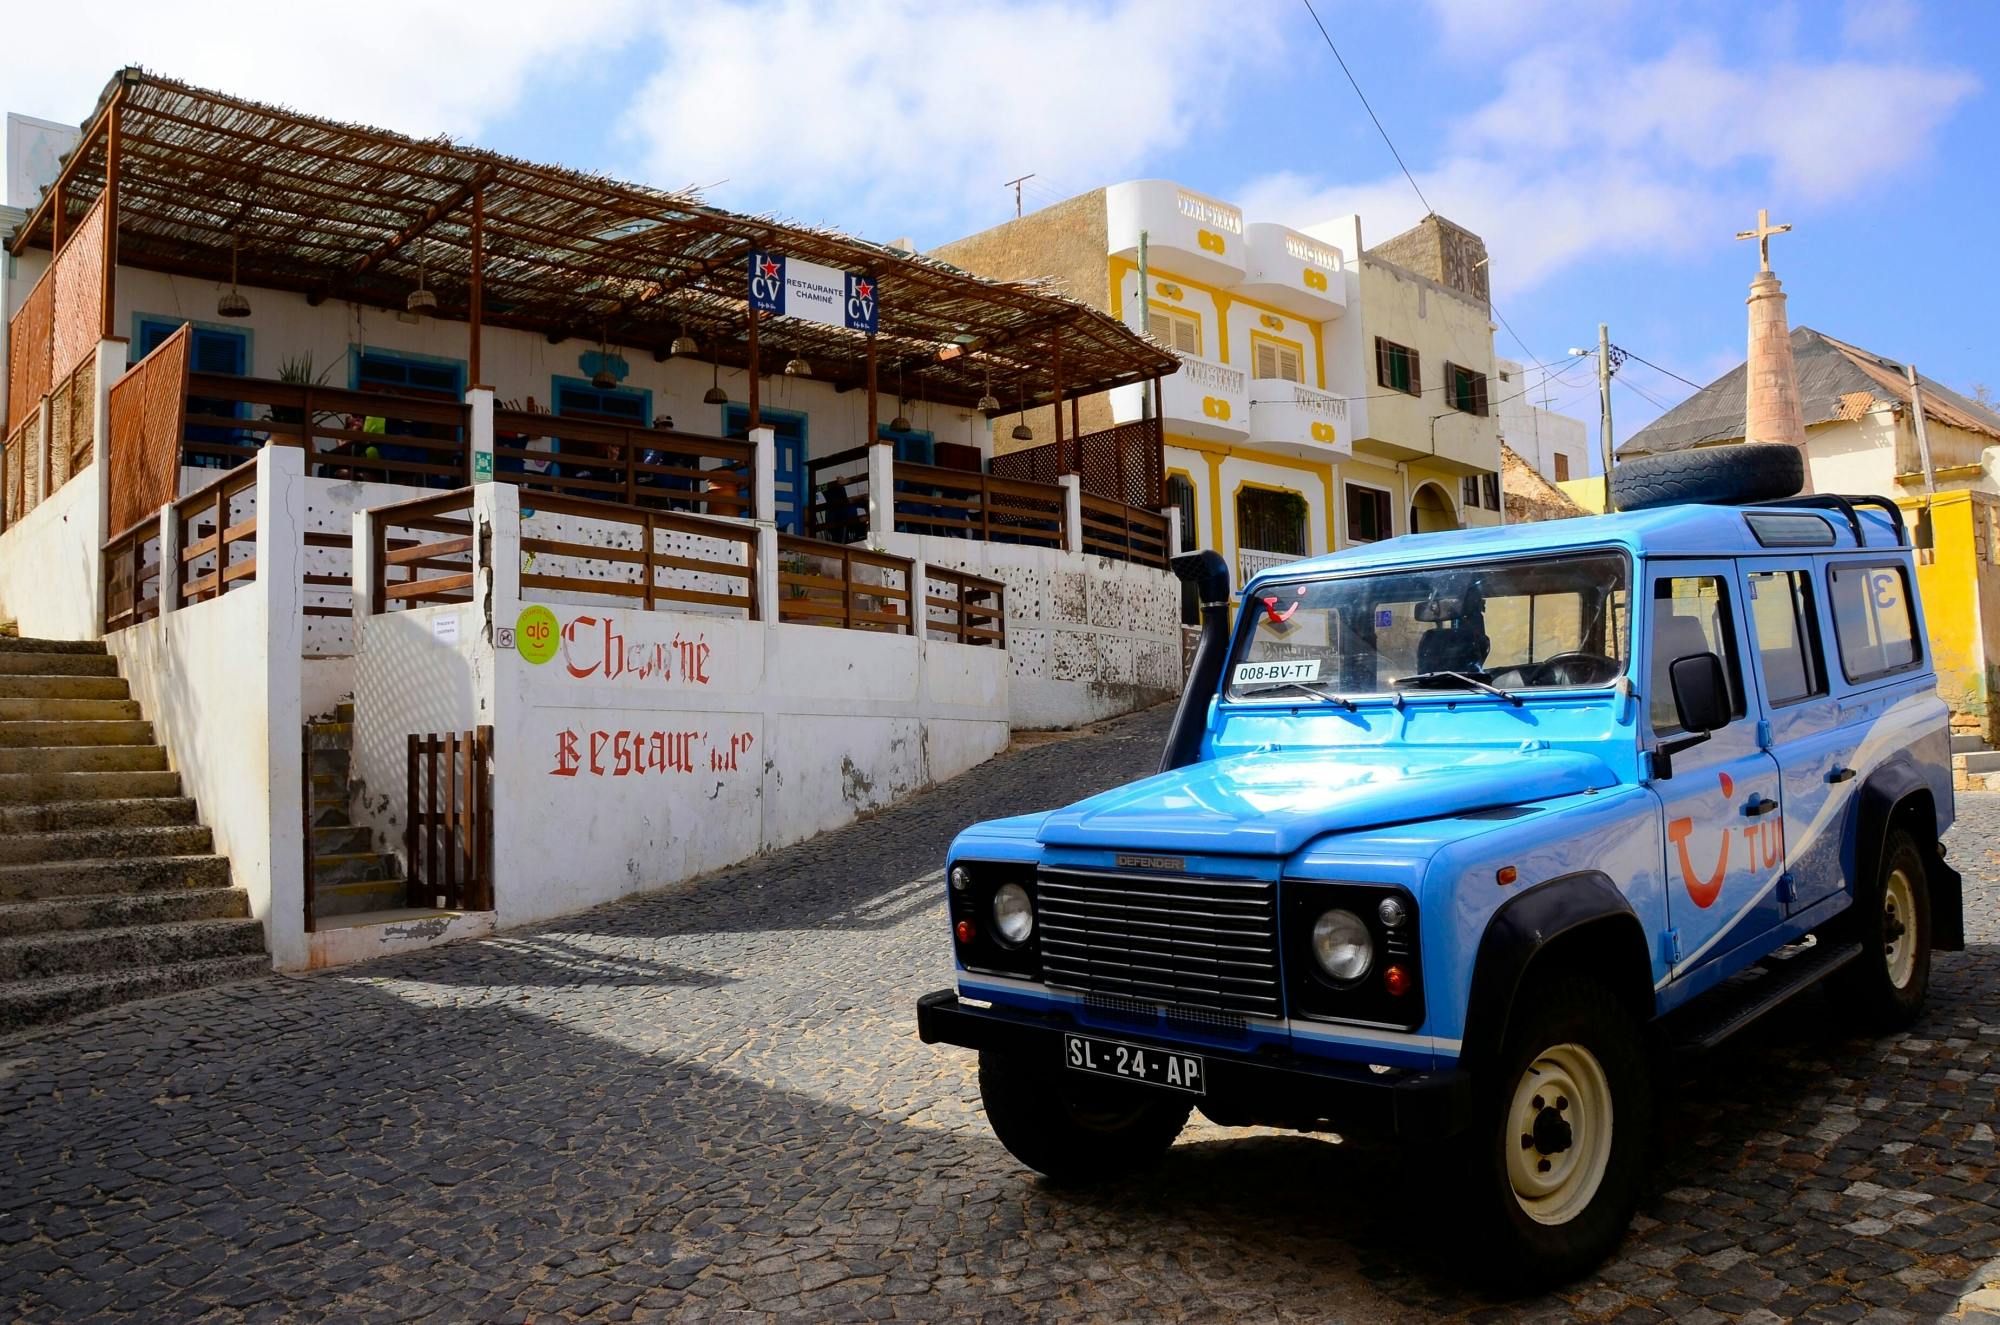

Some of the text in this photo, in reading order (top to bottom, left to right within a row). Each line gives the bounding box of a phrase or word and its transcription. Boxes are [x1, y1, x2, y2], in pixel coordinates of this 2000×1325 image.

[752, 276, 781, 301] CV
[786, 278, 844, 297] RESTAURANTE
[796, 290, 833, 304] CHAMINÉ
[848, 298, 874, 321] CV
[1240, 664, 1314, 681] 008-BV-TT
[1743, 816, 1784, 874] TUI
[1119, 856, 1181, 869] DEFENDER
